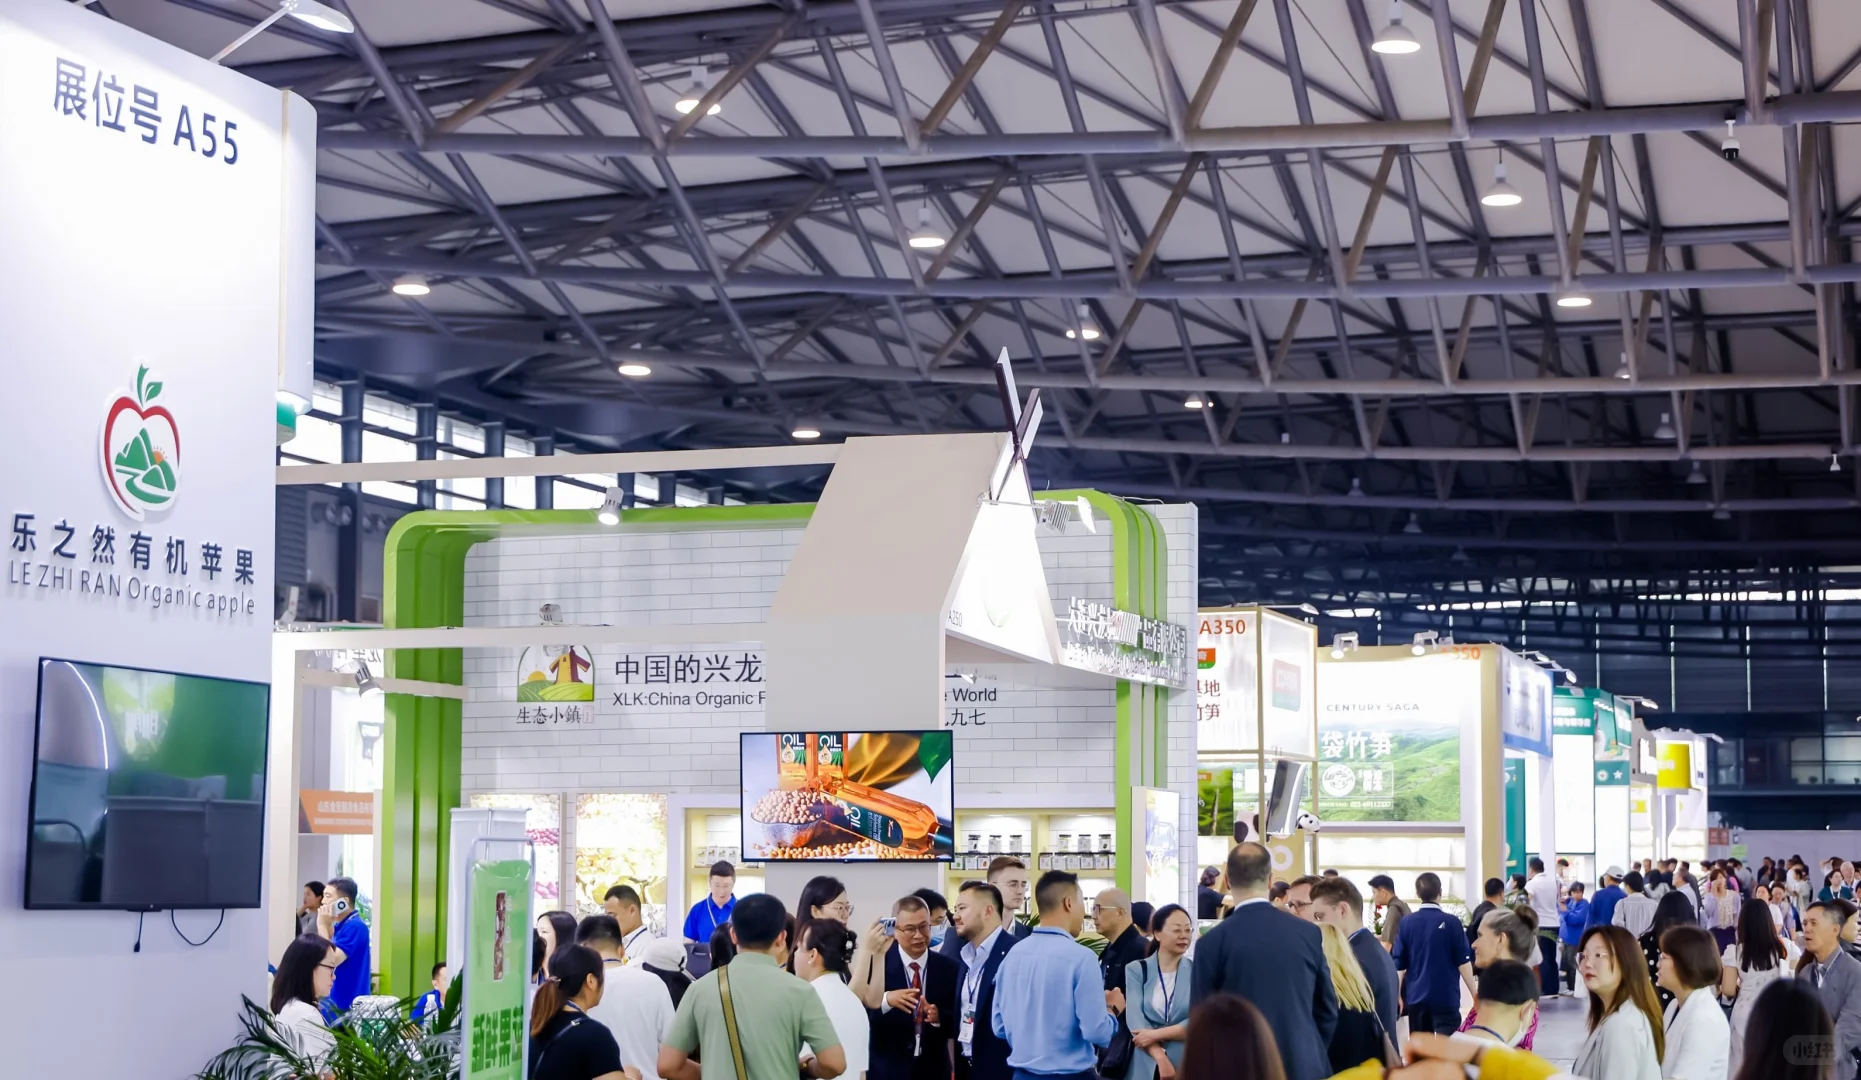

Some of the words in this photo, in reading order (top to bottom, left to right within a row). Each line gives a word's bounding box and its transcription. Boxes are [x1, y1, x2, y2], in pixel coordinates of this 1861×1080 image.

[54, 56, 162, 145] 展位号
[173, 104, 239, 165] A55
[12, 513, 255, 585] 乐之然有机苹果
[11, 560, 31, 585] LE
[38, 564, 72, 591] ZHI
[81, 570, 121, 597] RAN
[128, 577, 202, 608] Organic
[207, 592, 255, 618] apple
[1199, 619, 1246, 635] A350
[615, 653, 767, 685] 中国的兴龙
[612, 691, 690, 706] XLK:China
[695, 691, 753, 708] Organic
[952, 688, 997, 702] World
[1326, 703, 1381, 711] CENTURY
[1386, 703, 1420, 711] SAGA
[945, 709, 986, 726] 九七
[782, 734, 805, 746] OIL
[819, 735, 842, 747] OIL
